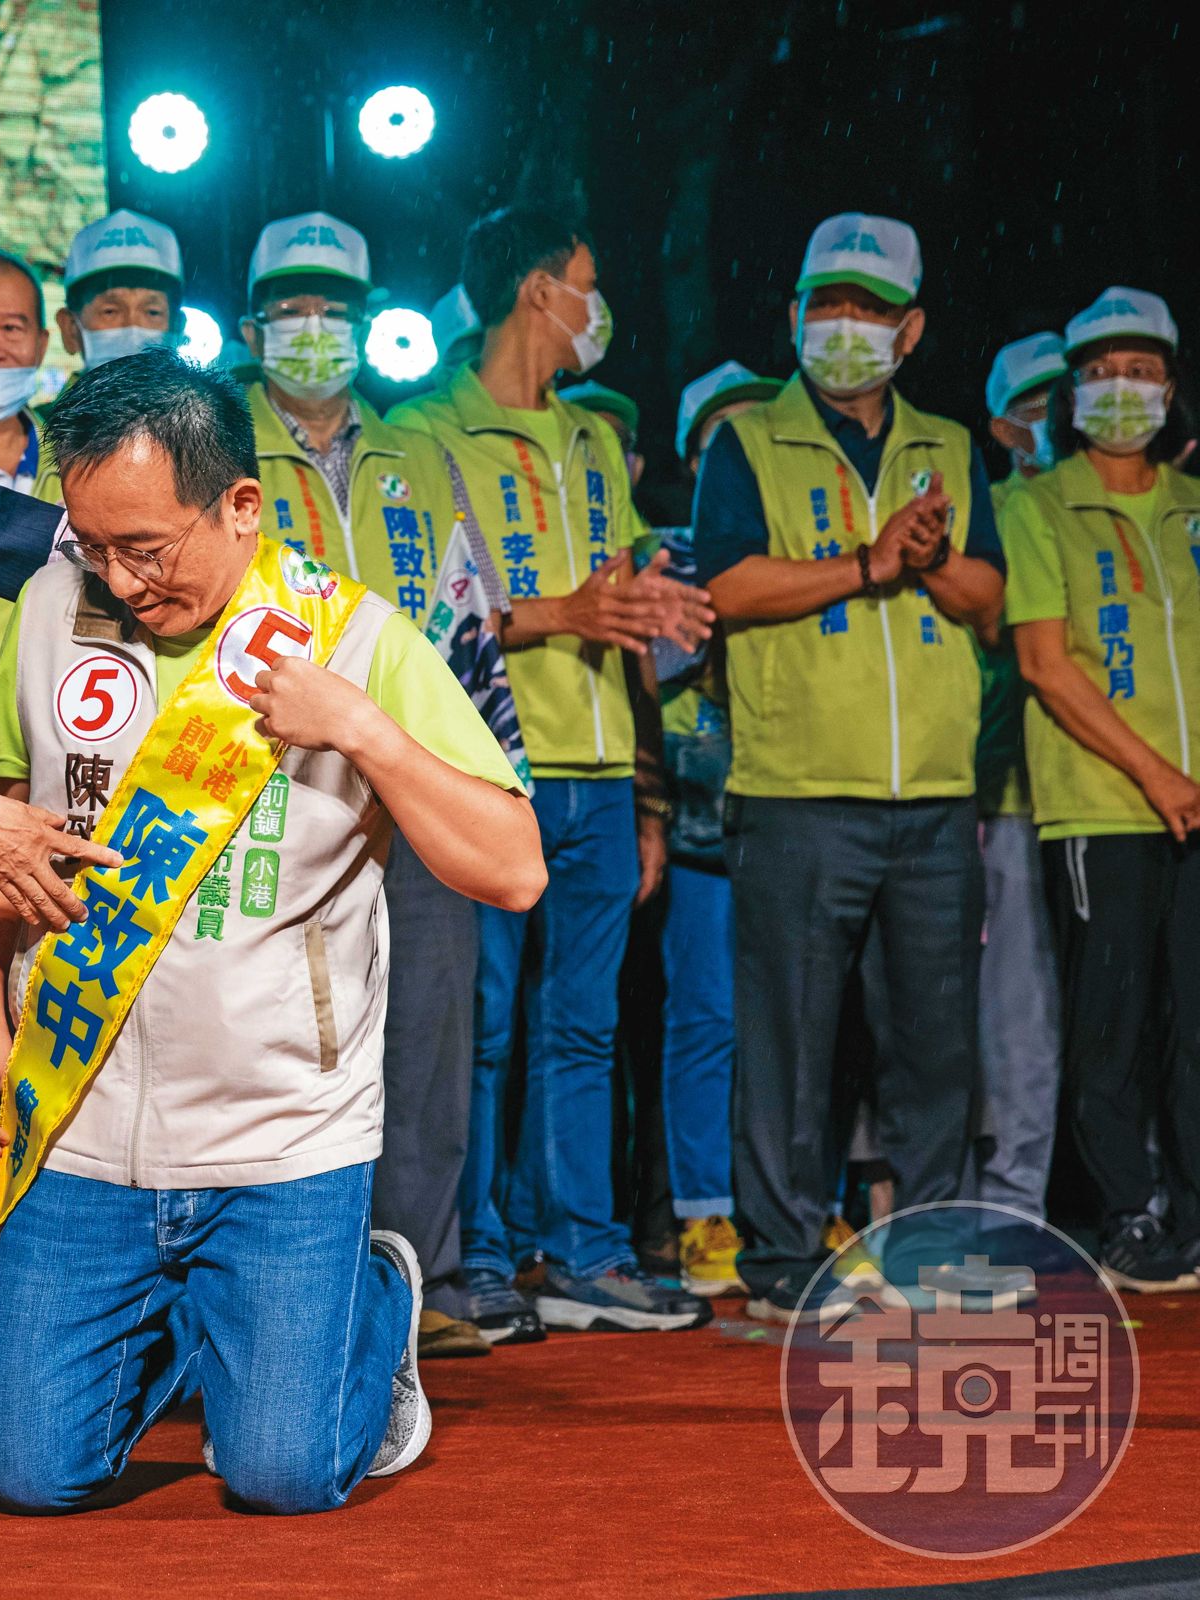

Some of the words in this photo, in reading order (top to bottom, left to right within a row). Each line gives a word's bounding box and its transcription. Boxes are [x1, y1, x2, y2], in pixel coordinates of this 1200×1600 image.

[382, 506, 426, 619] 陳致中
[451, 578, 470, 600] 4
[225, 610, 312, 702] 5
[72, 669, 119, 732] 5
[162, 714, 219, 783] 前鎮
[201, 740, 248, 803] 小港
[245, 856, 275, 910] 小港
[36, 787, 208, 1069] 陳致中
